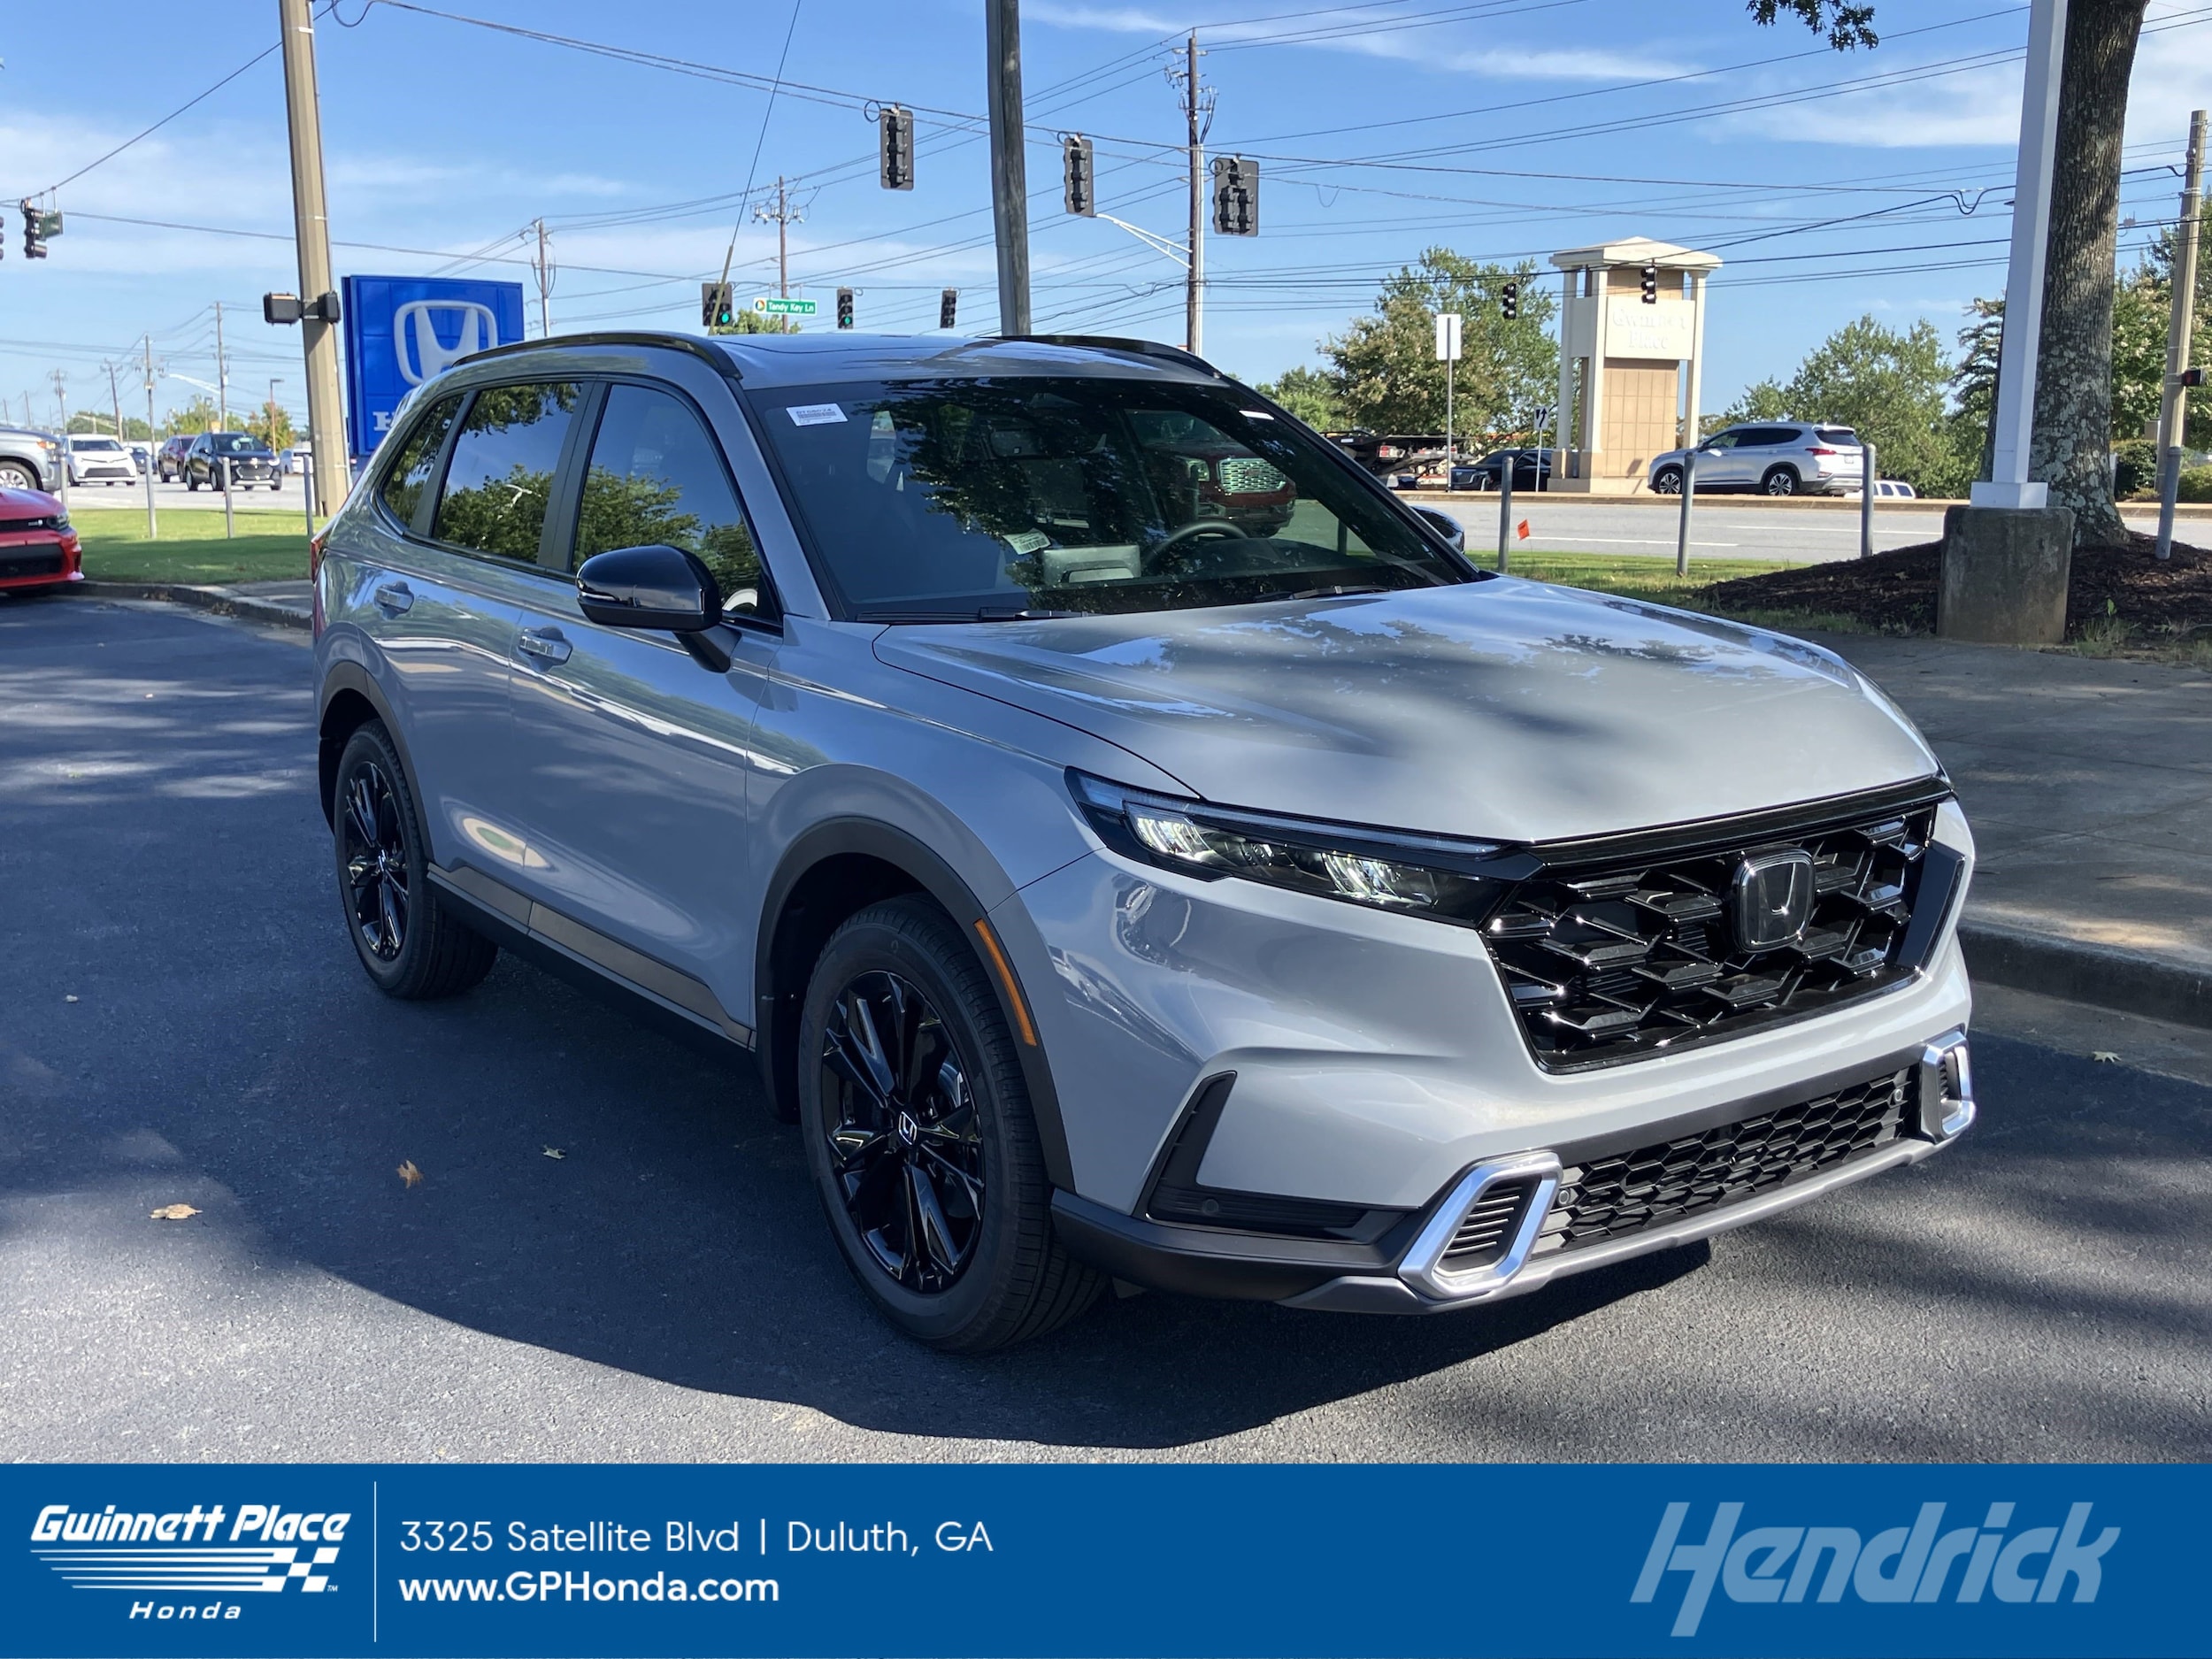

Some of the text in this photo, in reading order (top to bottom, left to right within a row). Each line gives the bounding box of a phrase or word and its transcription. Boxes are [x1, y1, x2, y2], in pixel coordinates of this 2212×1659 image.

[768, 302, 814, 313] Tandy Key Ln
[1612, 307, 1686, 329] Gwinnet
[1628, 330, 1669, 349] Place
